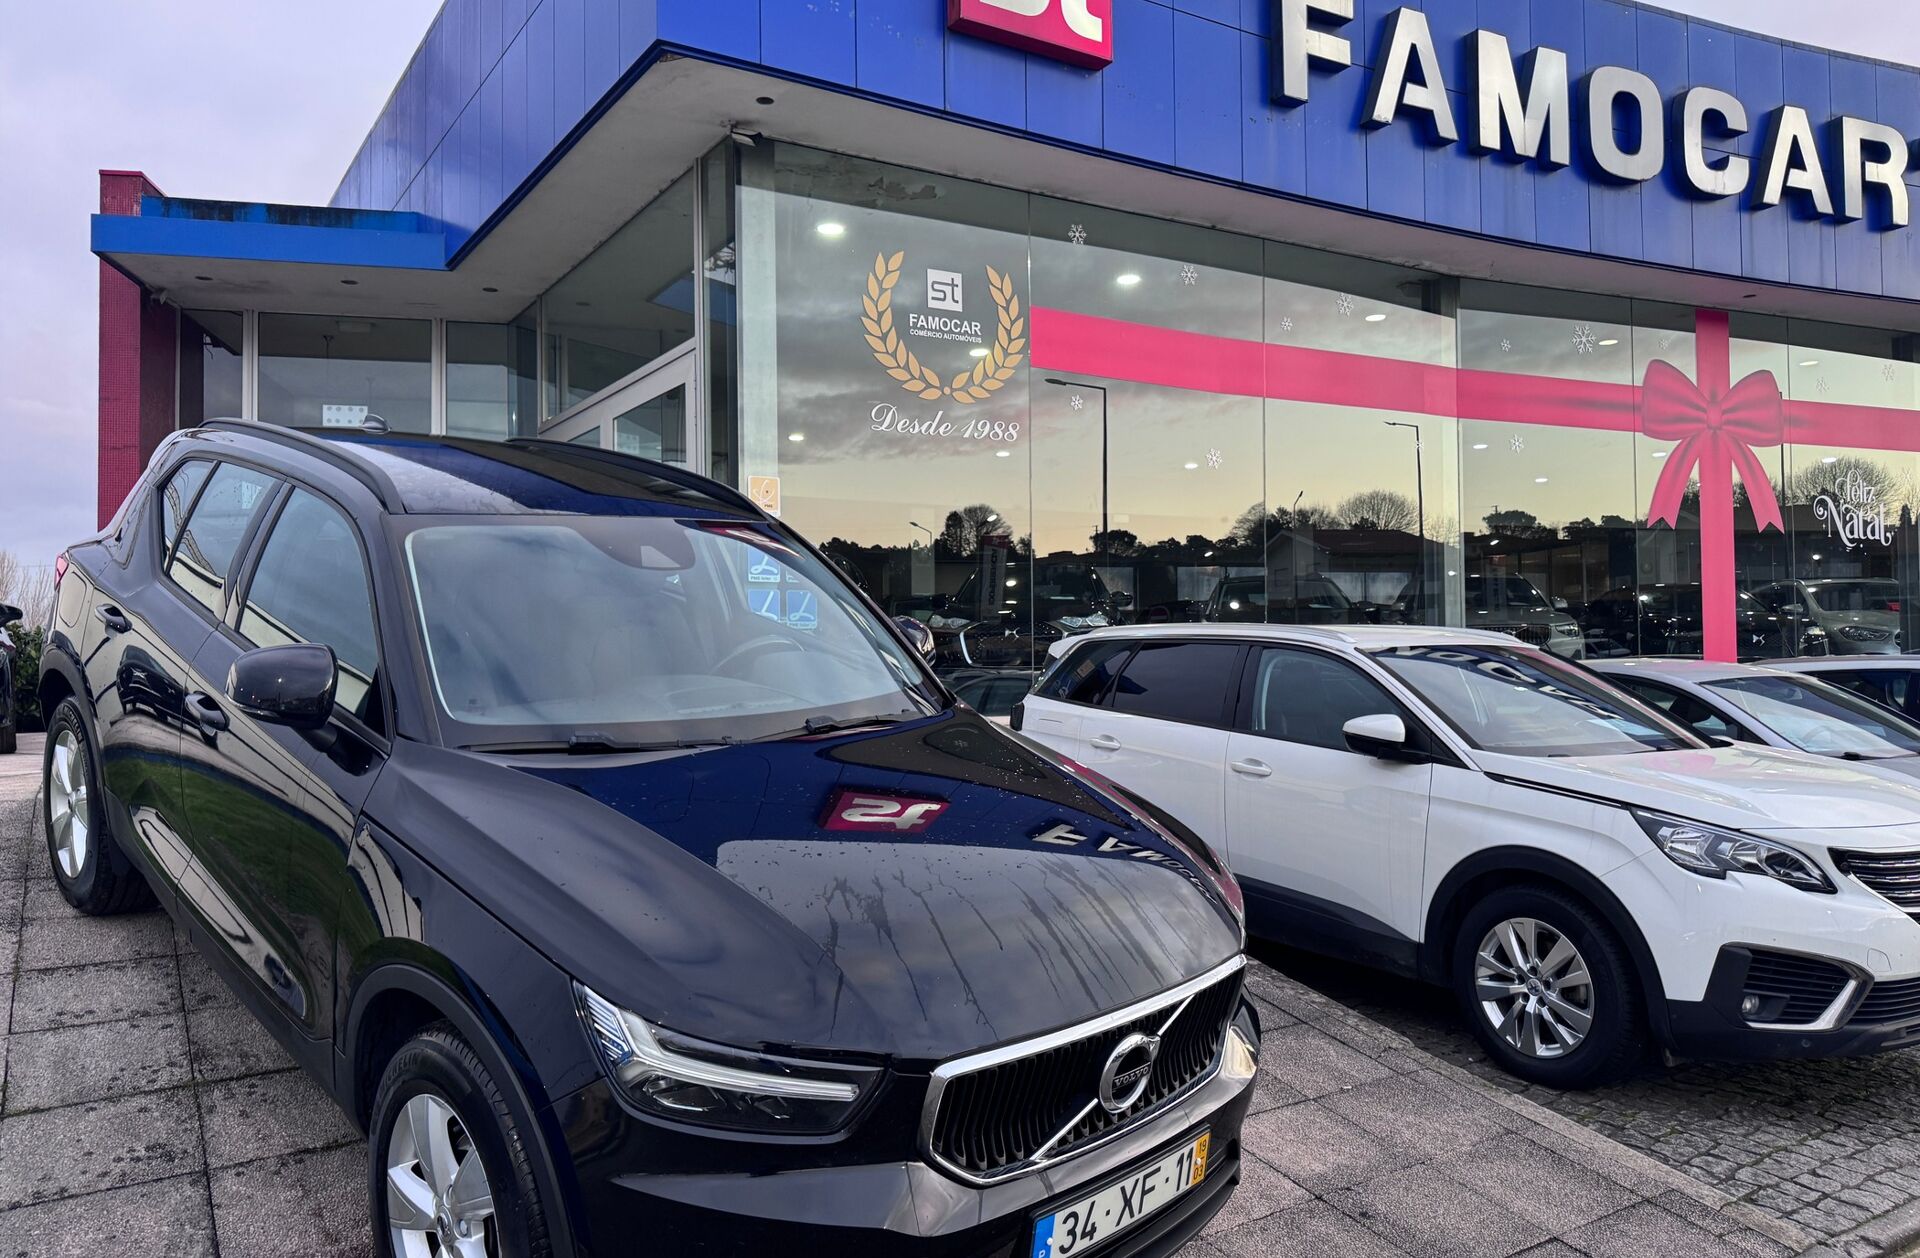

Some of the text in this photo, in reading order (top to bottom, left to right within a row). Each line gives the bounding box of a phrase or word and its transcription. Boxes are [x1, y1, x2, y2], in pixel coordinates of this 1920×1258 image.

[1273, 0, 1909, 226] FAMOCAR
[909, 313, 982, 336] FAMOCAR
[909, 328, 982, 344] COMÉRCIO AUTOMÓVEIS
[870, 403, 1020, 442] Desde 1988
[1813, 495, 1892, 547] Natal
[1114, 1066, 1149, 1087] VOLVO
